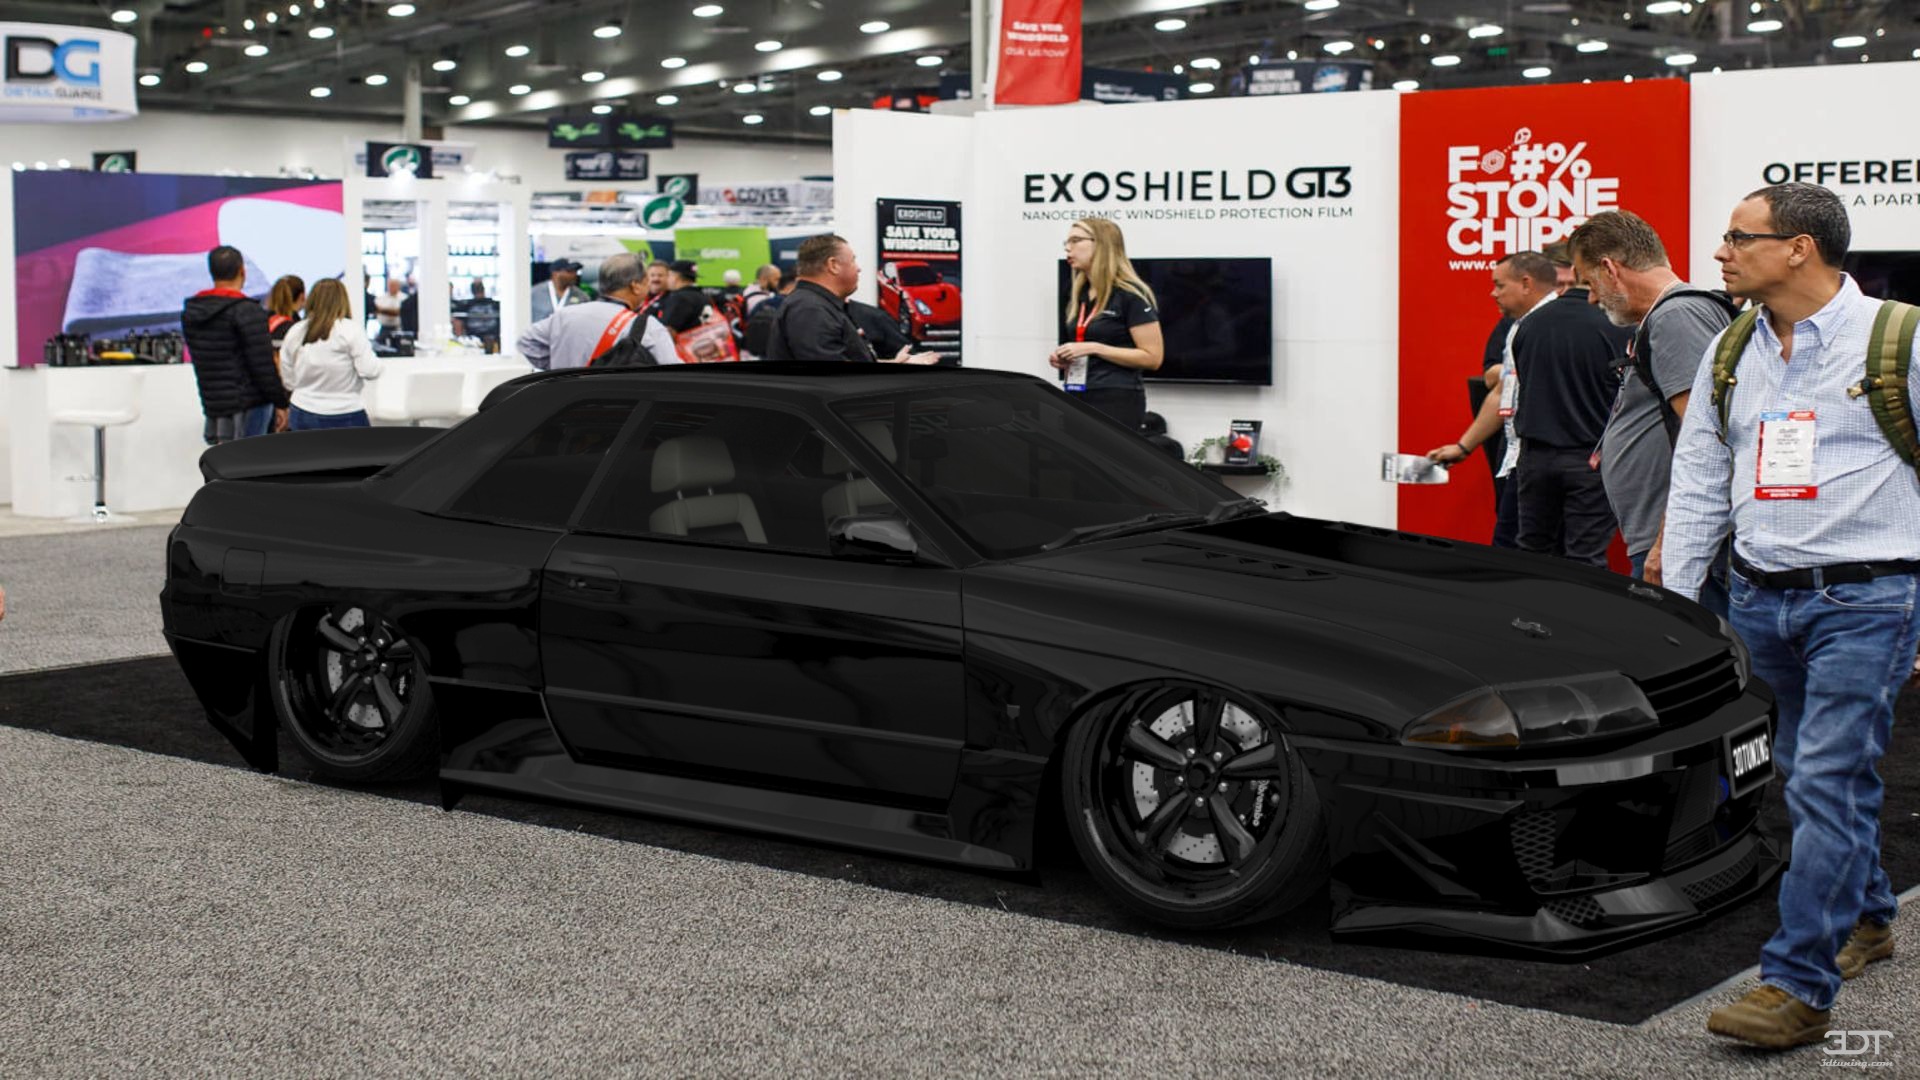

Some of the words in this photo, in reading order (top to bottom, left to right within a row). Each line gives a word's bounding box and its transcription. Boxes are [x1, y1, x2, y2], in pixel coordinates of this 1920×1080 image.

[1012, 21, 1037, 32] SAVE
[1006, 31, 1070, 43] WINDSHIELD
[4, 35, 100, 86] DG
[1762, 159, 1920, 185] OFFERE
[1024, 169, 1277, 203] EXOSHIELD
[1285, 165, 1352, 199] GT3
[736, 186, 788, 204] COVER
[1446, 177, 1620, 219] STONE
[1853, 194, 1867, 206] A
[1022, 209, 1122, 221] NANOCERAMIC
[1125, 208, 1216, 220] WINDSHIELD
[1219, 207, 1313, 219] PROTECTION
[1318, 206, 1353, 218] FILM
[886, 225, 920, 238] SAVE
[923, 226, 956, 239] YOUR
[883, 237, 960, 252] WINDSHIELD
[1731, 733, 1770, 778] 3DTUNING
